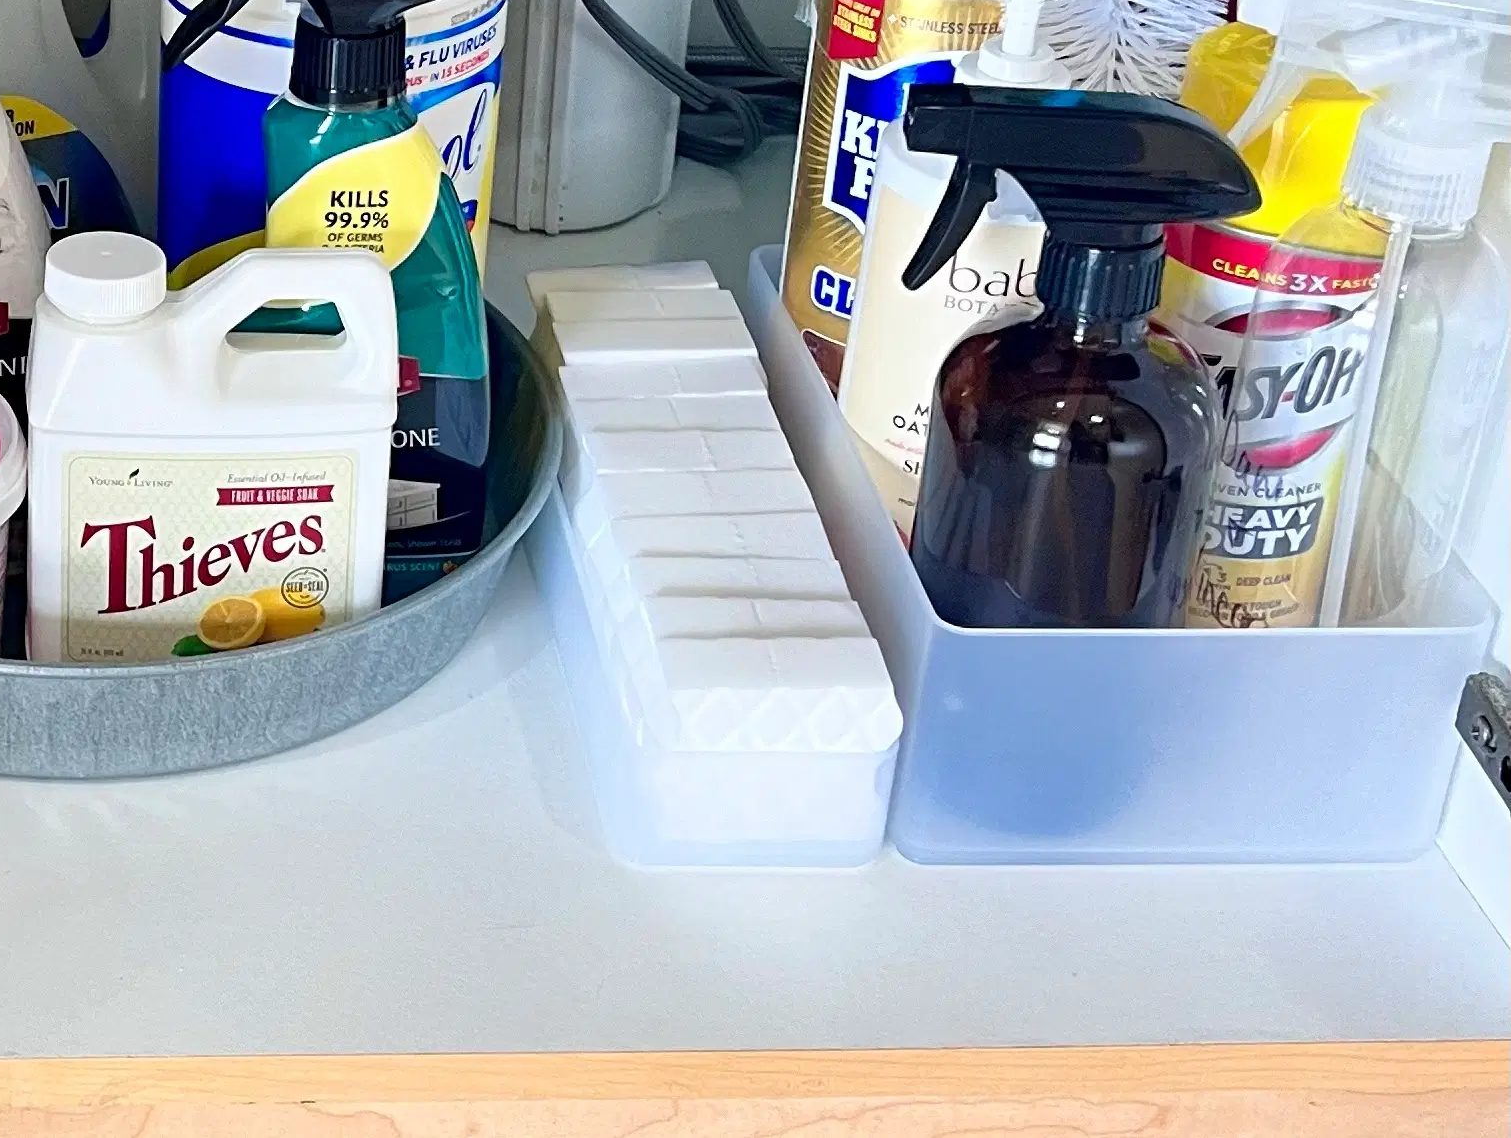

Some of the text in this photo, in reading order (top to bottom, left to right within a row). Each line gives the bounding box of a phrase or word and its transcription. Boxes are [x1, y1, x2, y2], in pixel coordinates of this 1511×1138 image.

[419, 46, 450, 68] FLU
[453, 21, 499, 59] VIRUSES
[330, 190, 388, 208] KILLS
[324, 212, 389, 229] 99.9%
[328, 233, 383, 242] OF GERMS
[1212, 258, 1288, 286] CLEANS
[1290, 273, 1328, 293] 3X
[227, 471, 326, 483] Essential Oil-Infused
[231, 490, 254, 503] FRUIT
[266, 489, 294, 502] VEGGIE
[297, 488, 319, 501] SOAK
[1254, 483, 1321, 498] CLEANER
[1206, 503, 1317, 529] HEAVY
[1202, 524, 1311, 555] DUTY
[81, 514, 325, 615] Thieves
